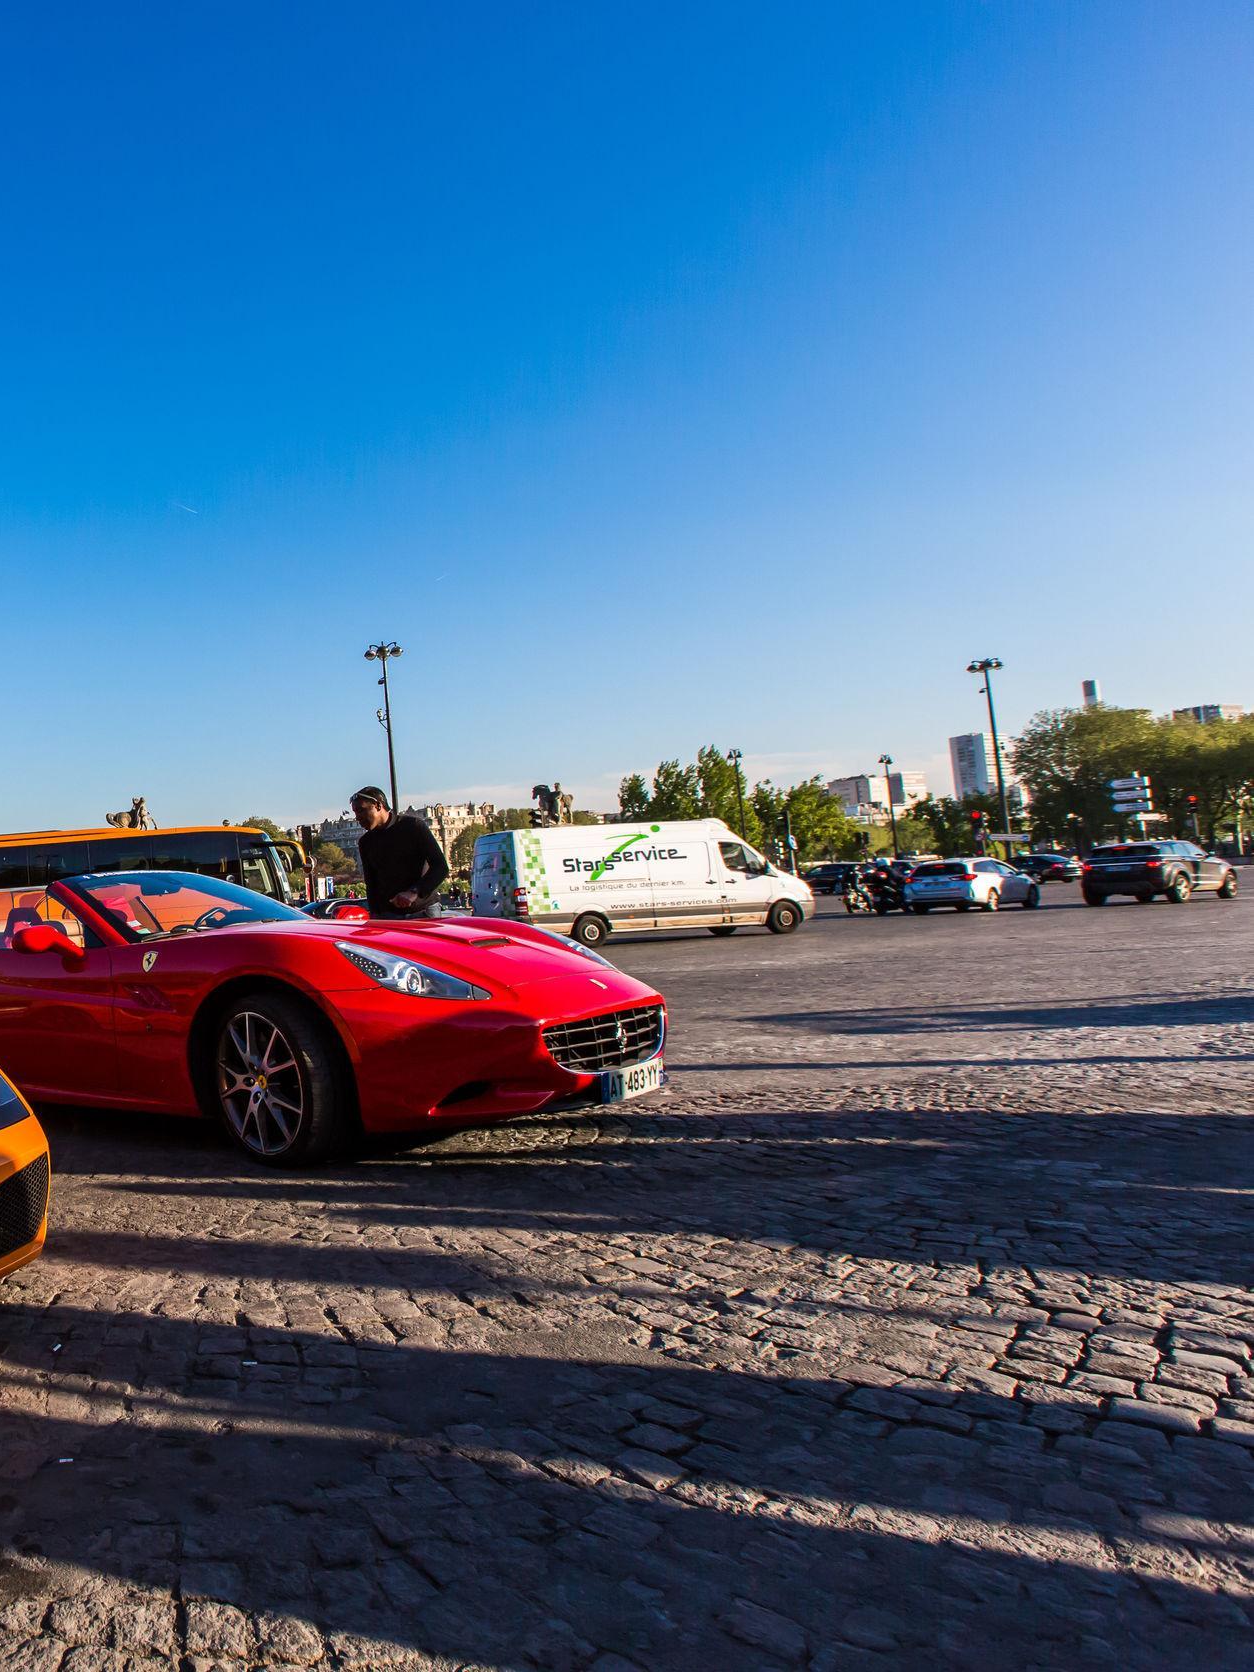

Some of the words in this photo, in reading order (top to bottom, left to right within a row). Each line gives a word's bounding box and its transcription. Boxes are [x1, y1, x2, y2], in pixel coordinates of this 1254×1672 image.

[611, 845, 688, 863] service
[582, 882, 624, 892] logistique
[639, 880, 669, 888] dernier
[610, 897, 738, 910] www.stars-services.com
